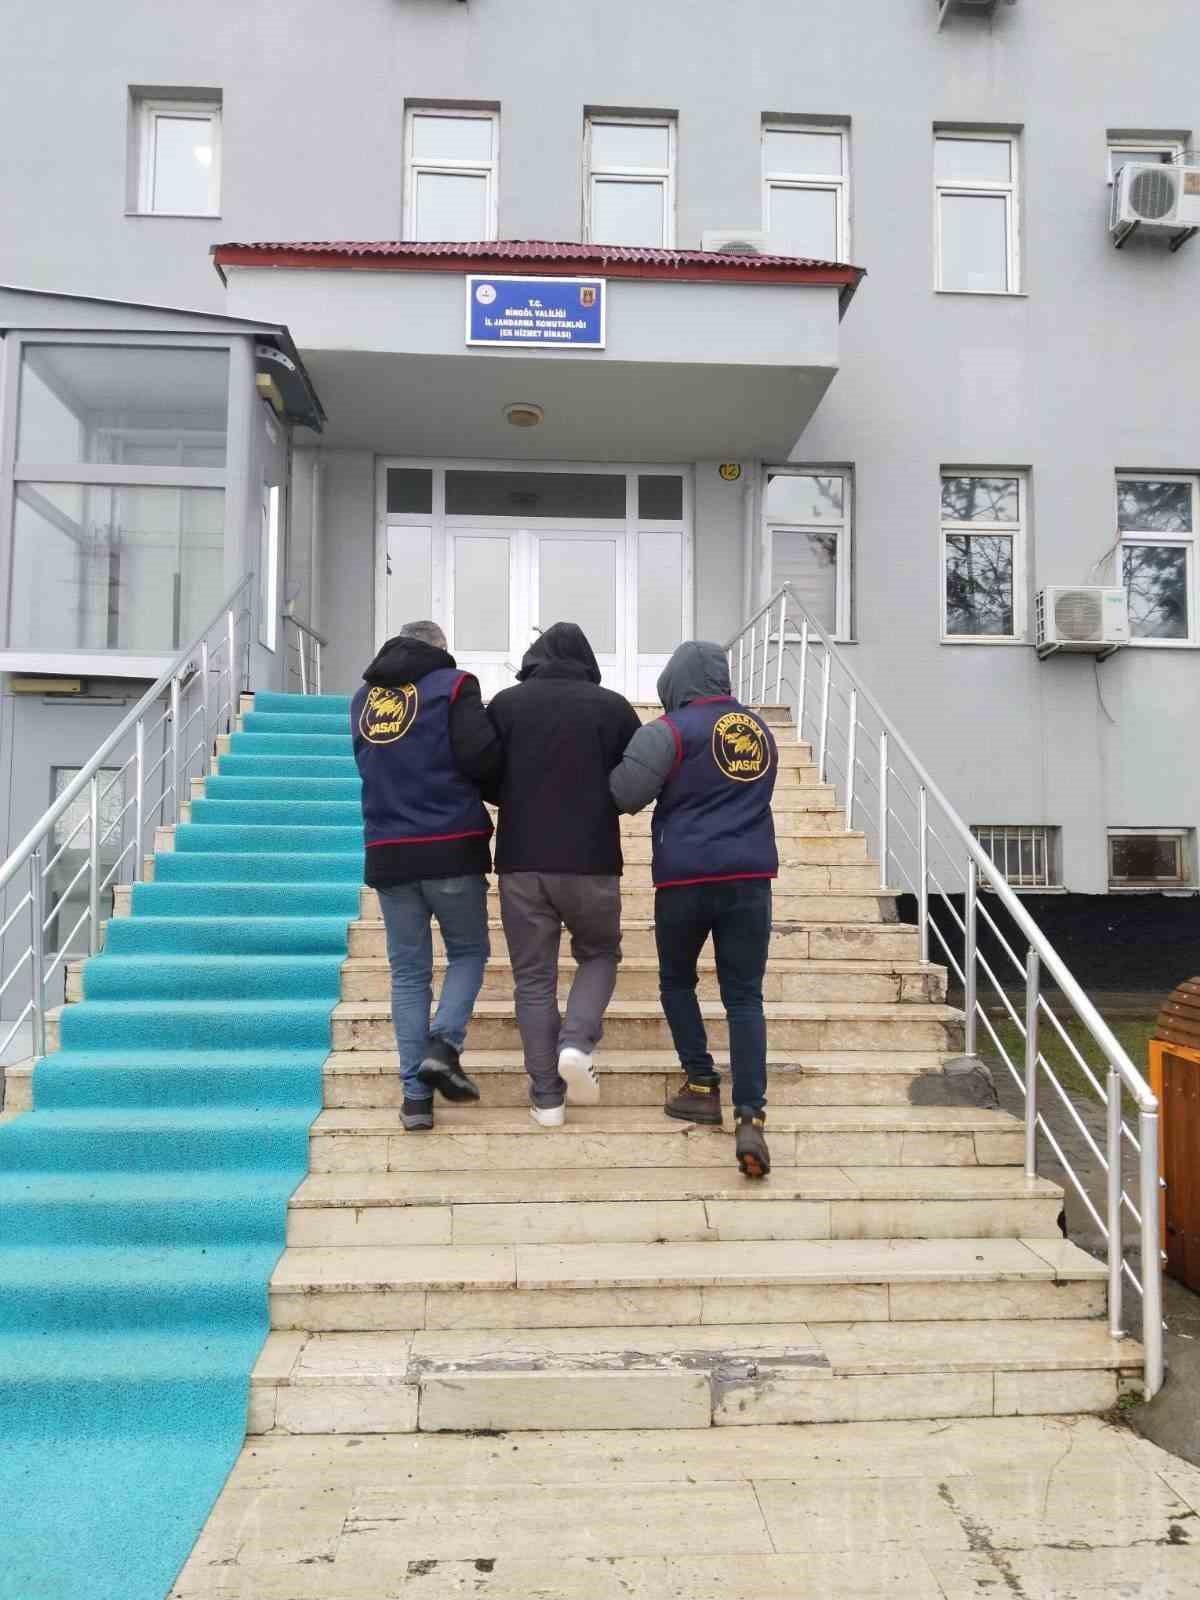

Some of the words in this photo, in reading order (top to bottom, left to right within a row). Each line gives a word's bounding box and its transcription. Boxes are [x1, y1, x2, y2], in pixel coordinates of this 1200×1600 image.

[528, 299, 543, 307] T.C.
[505, 307, 533, 317] BİNGÖL
[494, 318, 533, 327] JANDARMA
[536, 318, 586, 329] KOMUTANLIĞI
[369, 721, 401, 736] JASAT
[728, 760, 760, 772] JASAT
